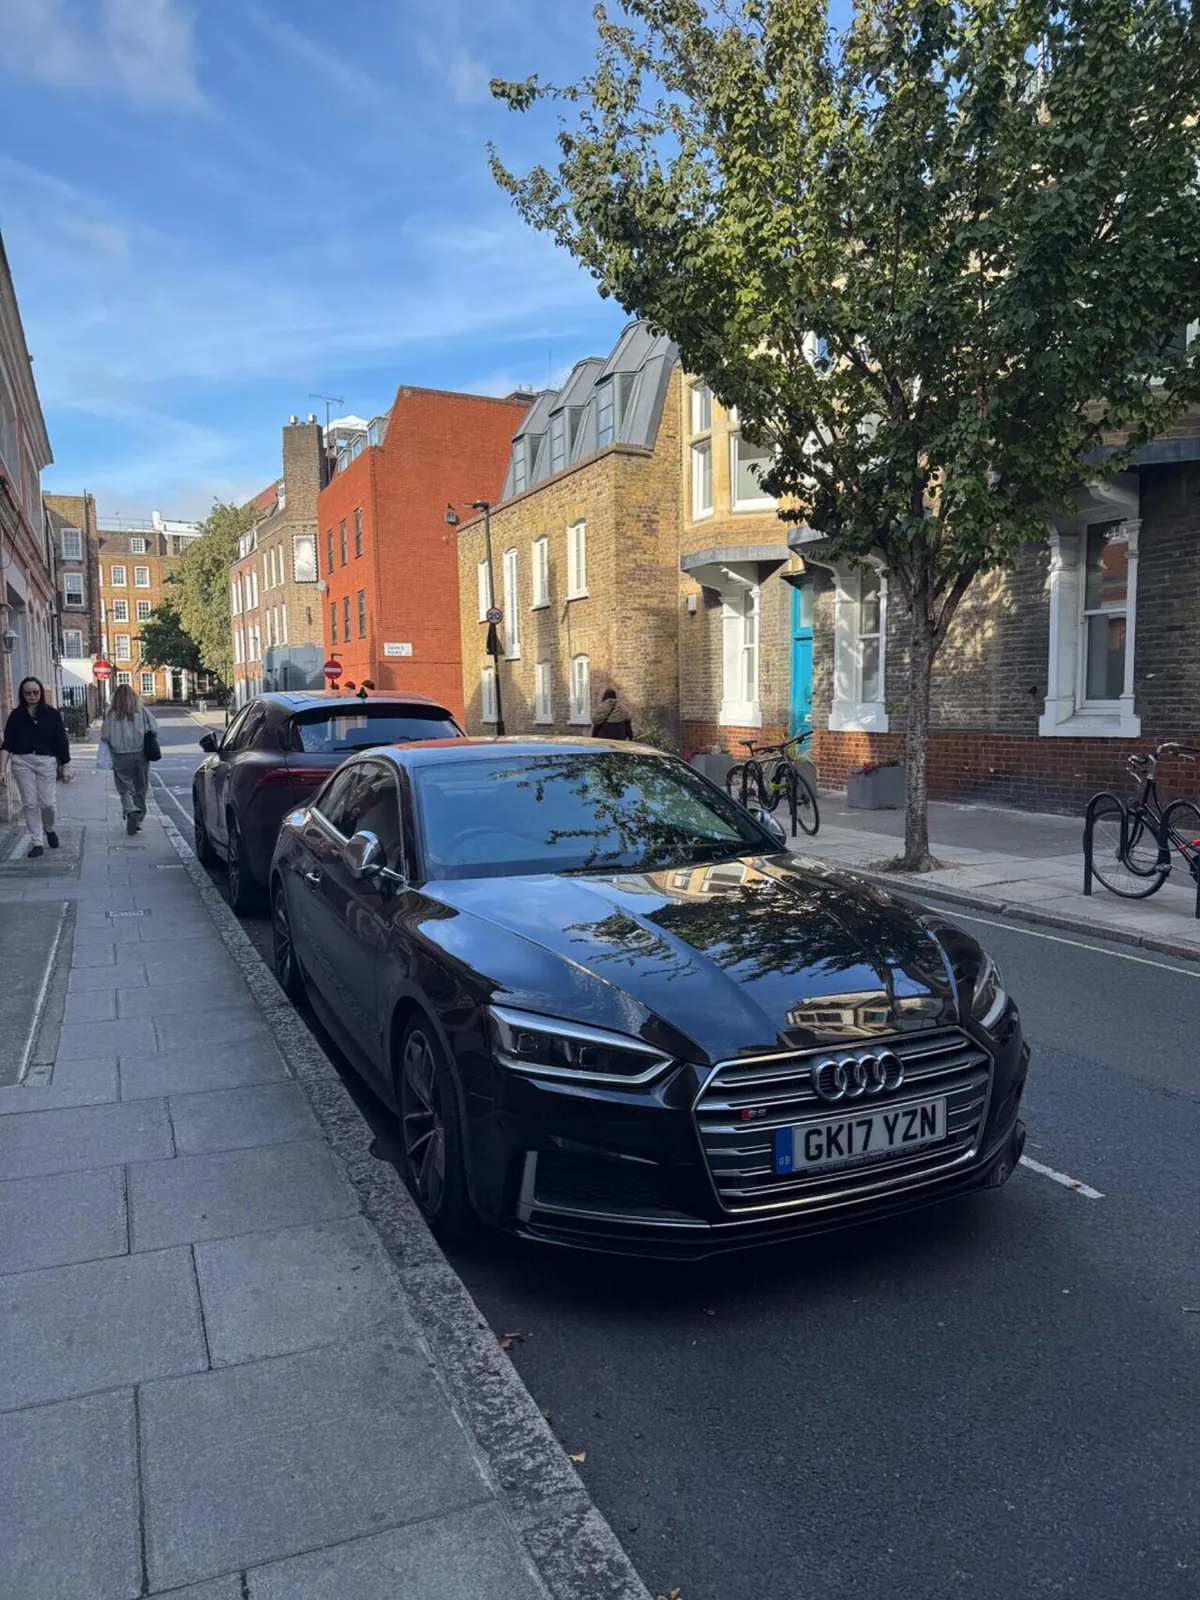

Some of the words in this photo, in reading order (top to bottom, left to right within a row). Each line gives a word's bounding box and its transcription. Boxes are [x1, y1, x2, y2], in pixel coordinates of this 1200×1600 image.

[488, 612, 500, 620] 20
[804, 1118, 874, 1162] GK17
[883, 1104, 937, 1146] YZN
[778, 1155, 791, 1166] GB
